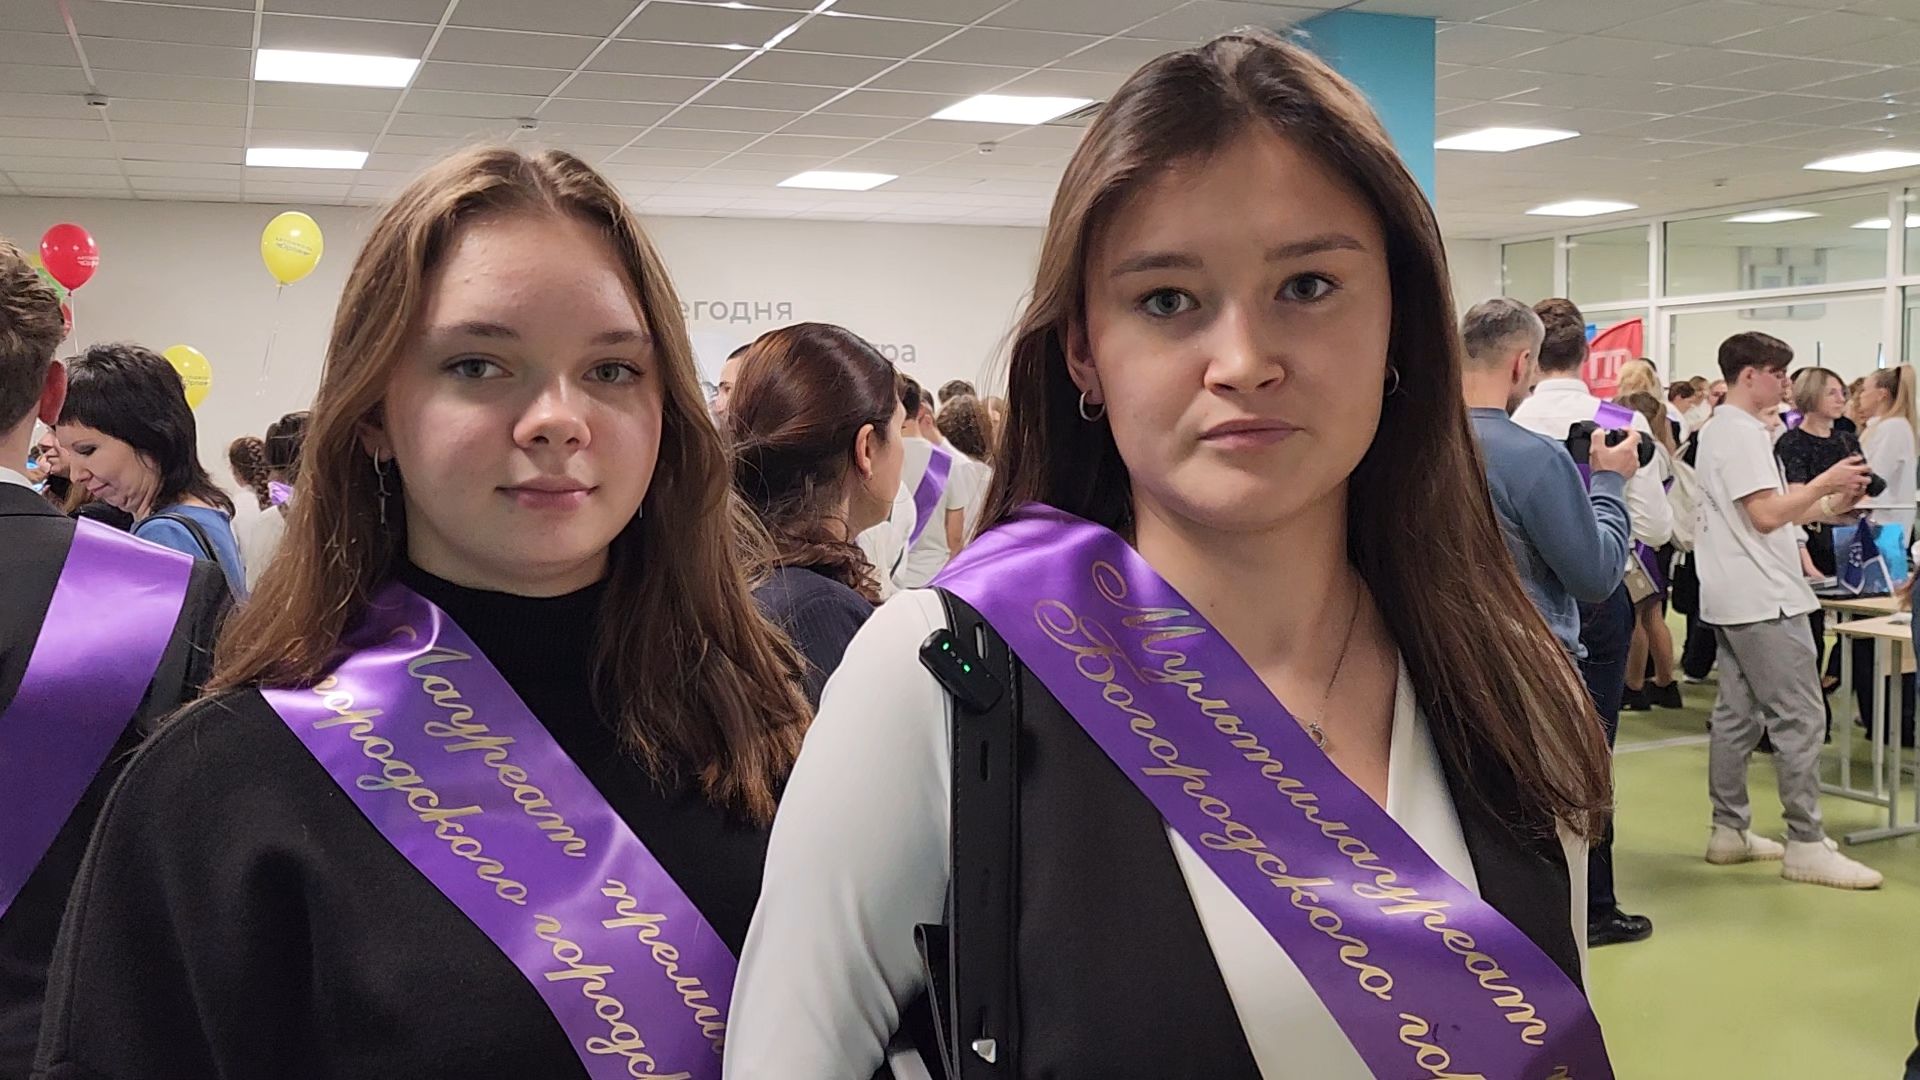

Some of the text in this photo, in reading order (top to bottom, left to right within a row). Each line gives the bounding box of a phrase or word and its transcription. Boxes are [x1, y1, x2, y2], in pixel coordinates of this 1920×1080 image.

[391, 625, 587, 857] Лауреат
[1034, 599, 1393, 1000] Богородского
[1092, 561, 1547, 1045] Мультилауреат
